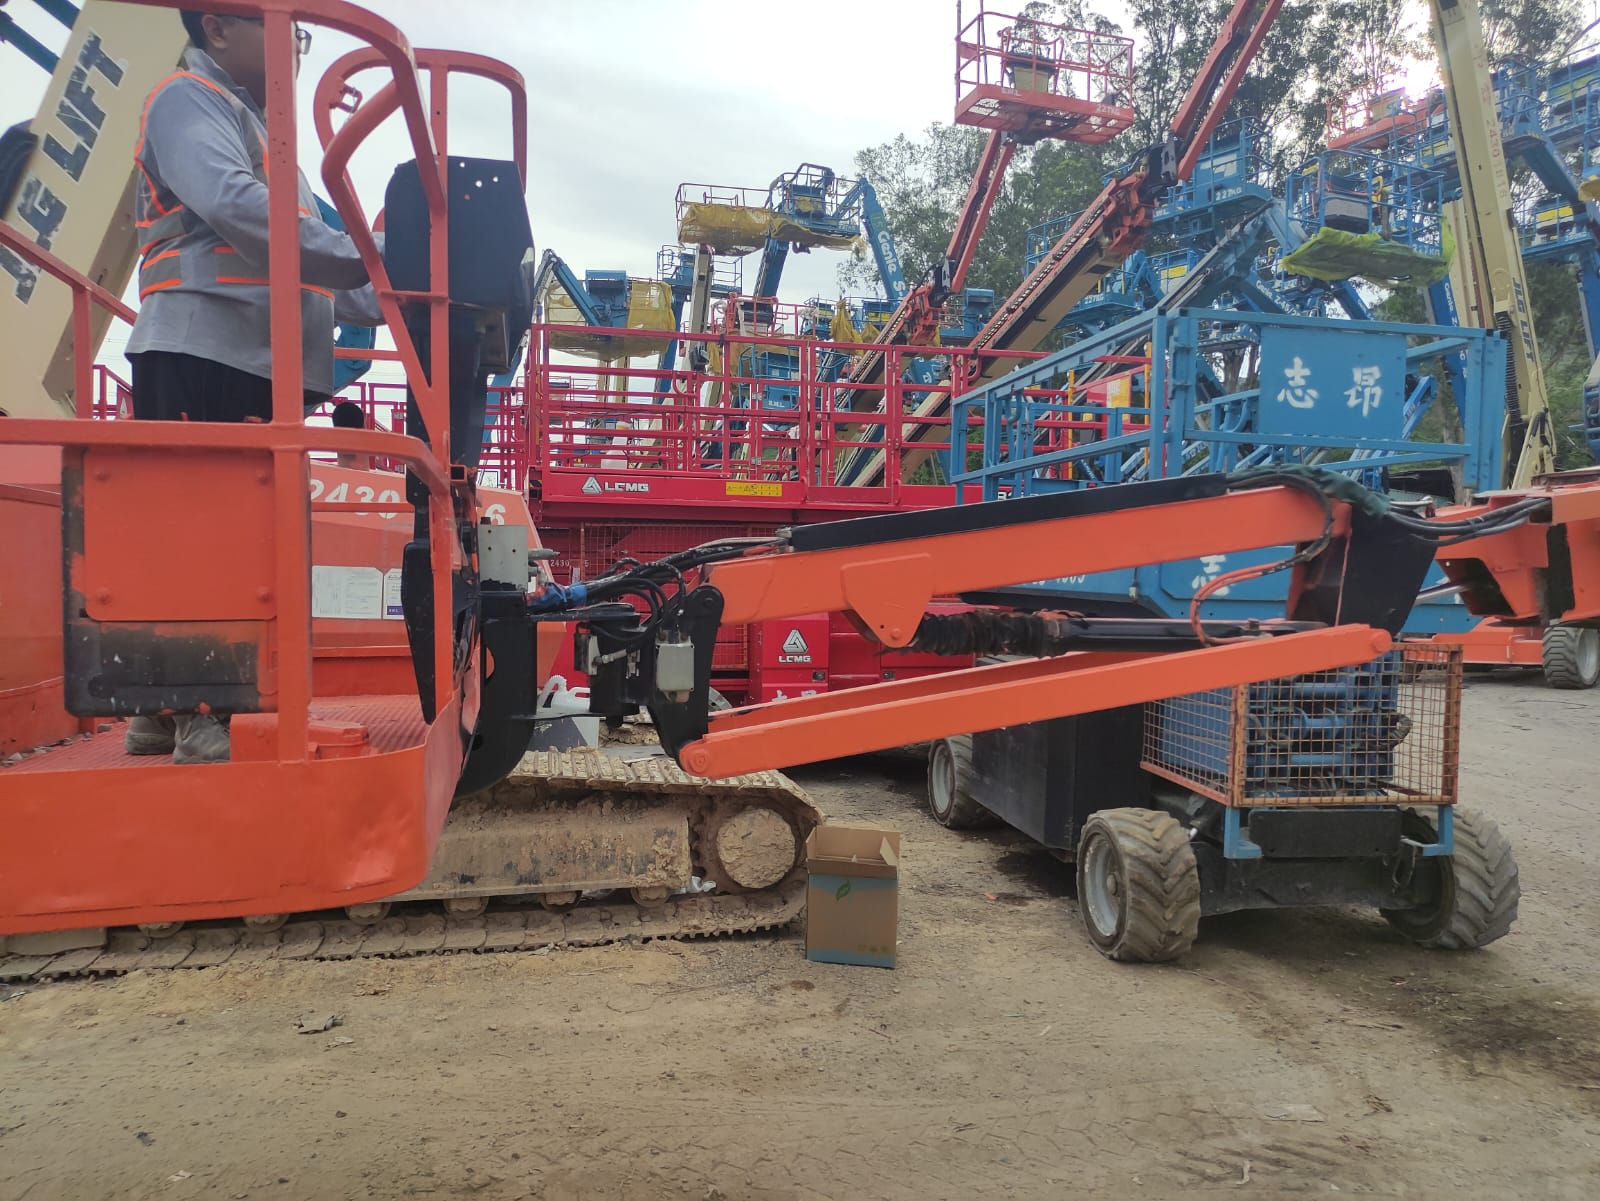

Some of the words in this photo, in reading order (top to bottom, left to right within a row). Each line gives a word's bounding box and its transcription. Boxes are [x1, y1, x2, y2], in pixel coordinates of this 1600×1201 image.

[40, 28, 127, 183] LIFT
[877, 230, 898, 276] Genie
[1512, 277, 1526, 314] JLG
[1520, 319, 1535, 362] LIFT
[604, 481, 650, 493] LCMG
[550, 559, 571, 568] 2430
[778, 655, 812, 663] LCMG
